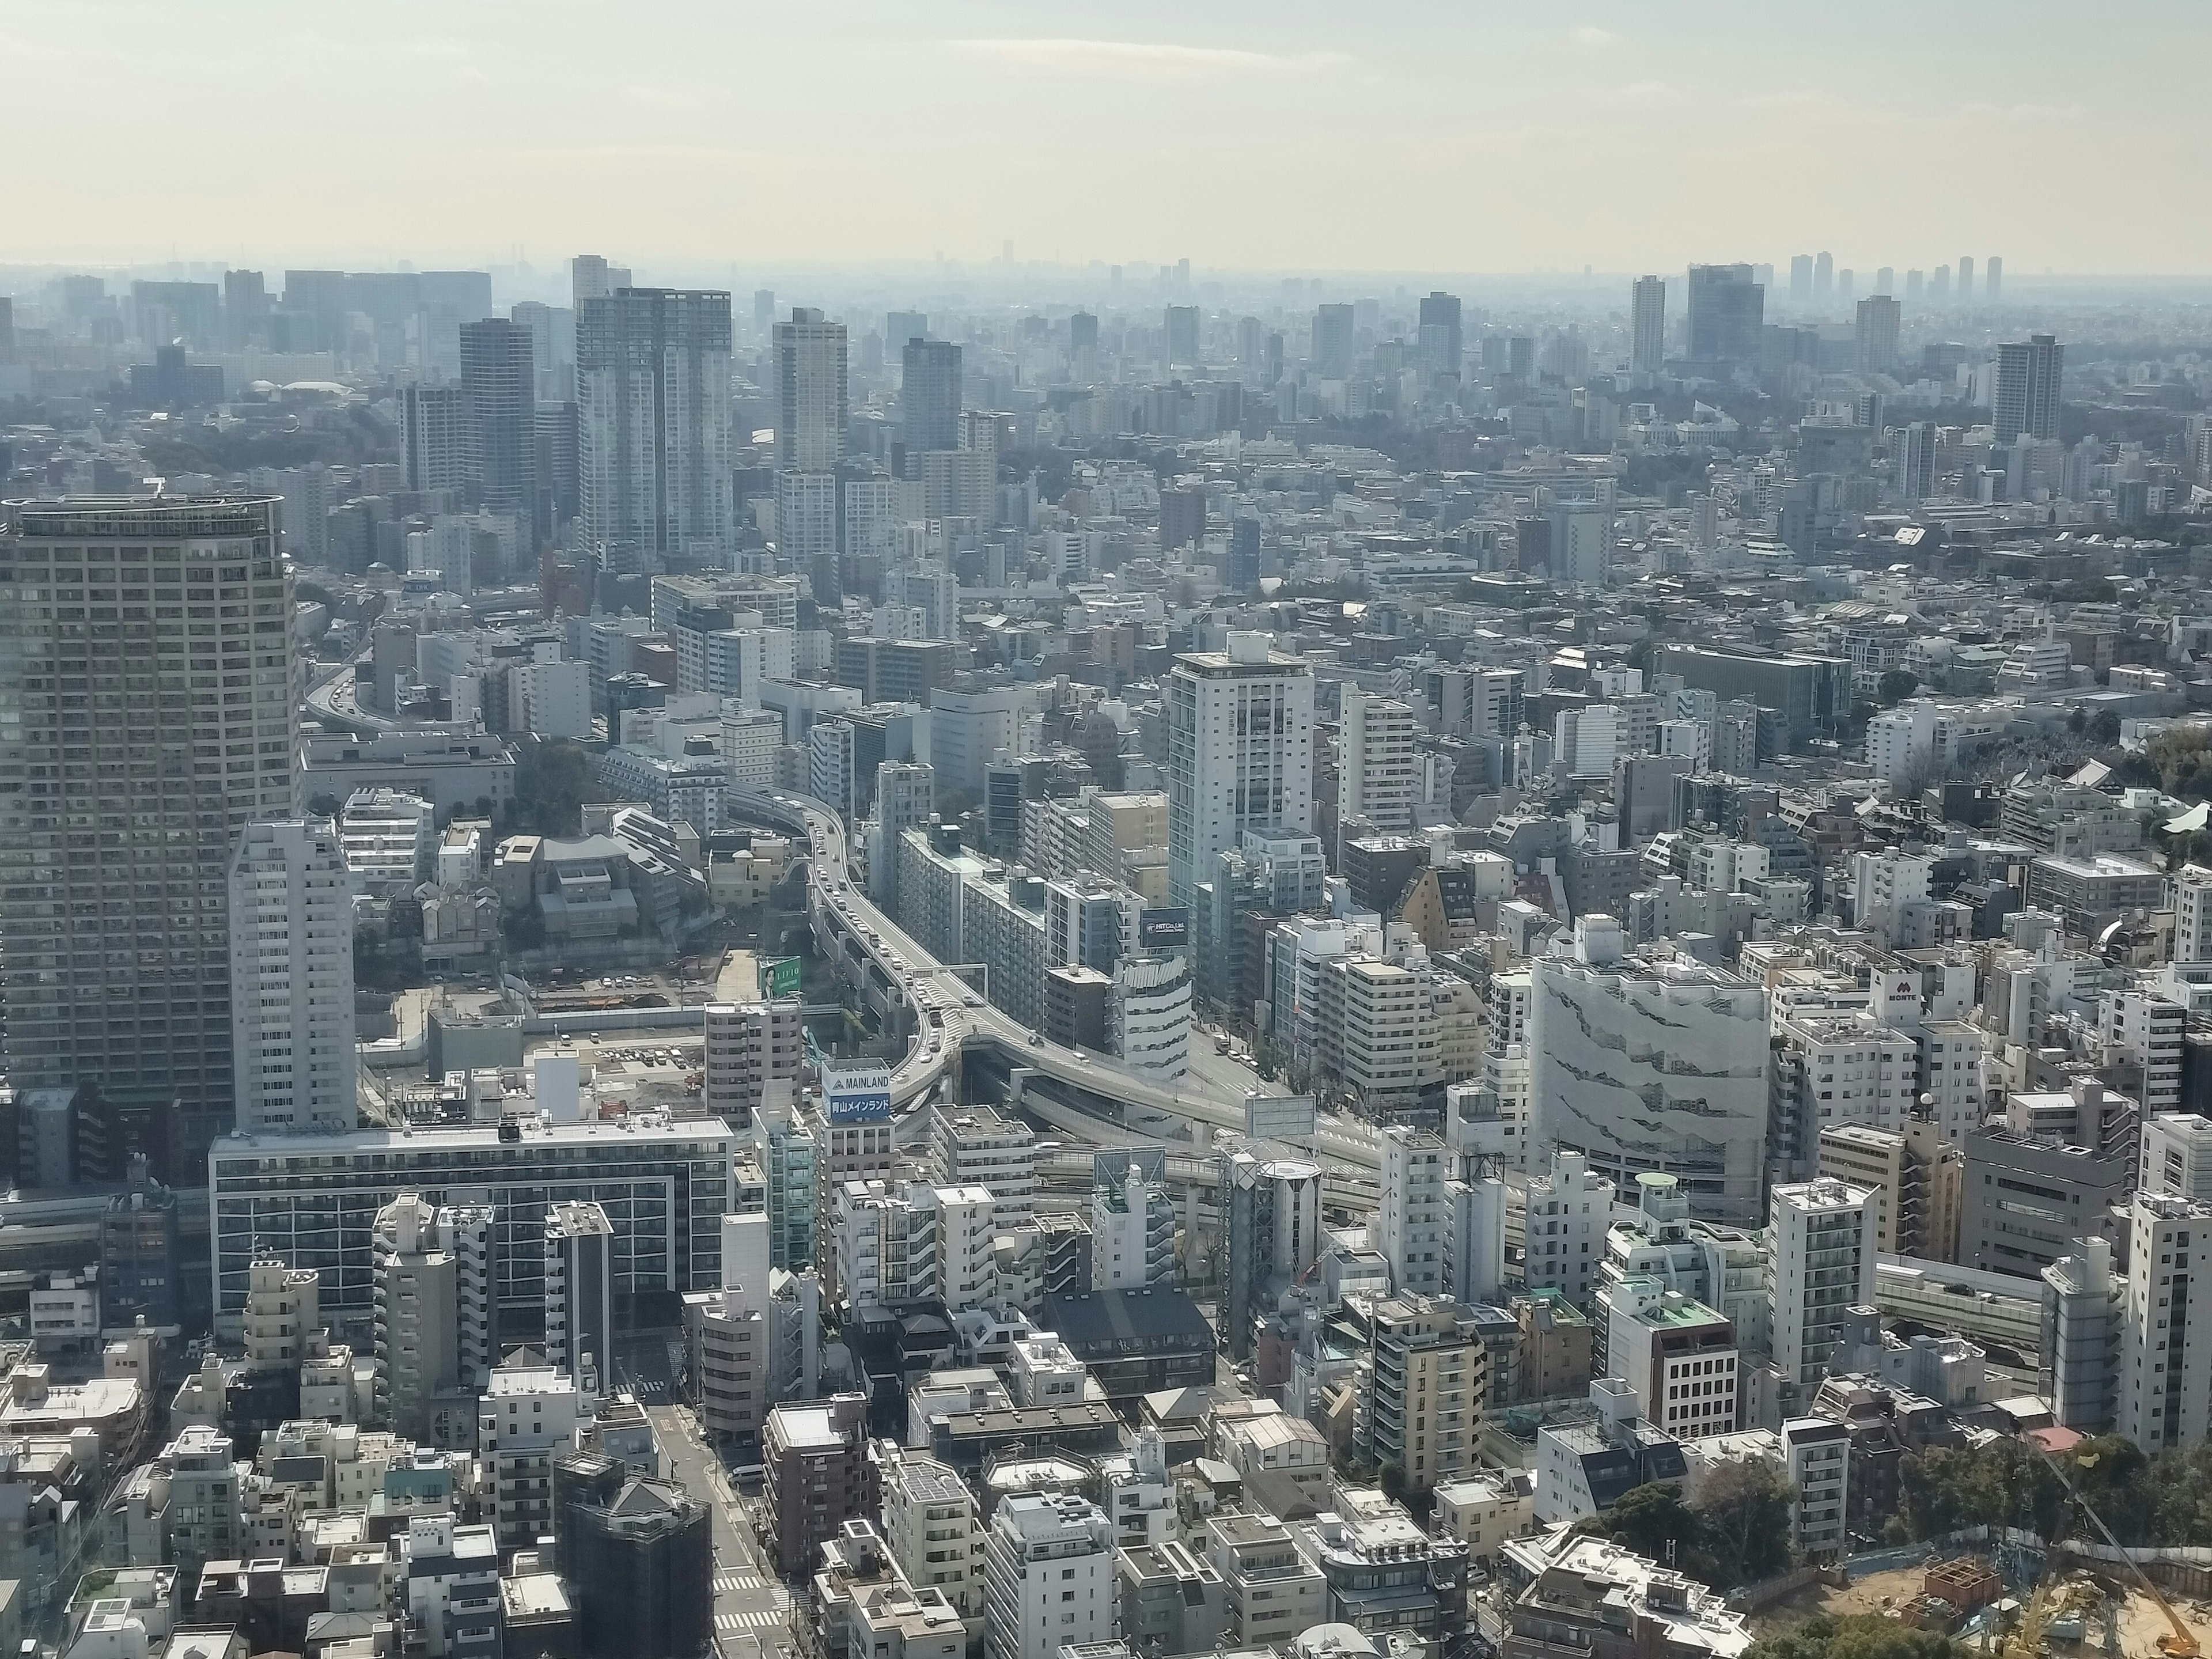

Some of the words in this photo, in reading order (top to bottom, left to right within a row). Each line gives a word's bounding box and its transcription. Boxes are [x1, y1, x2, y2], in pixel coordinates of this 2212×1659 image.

[846, 1076, 889, 1089] MAINLAND
[832, 1099, 889, 1113] 青山メインランド
